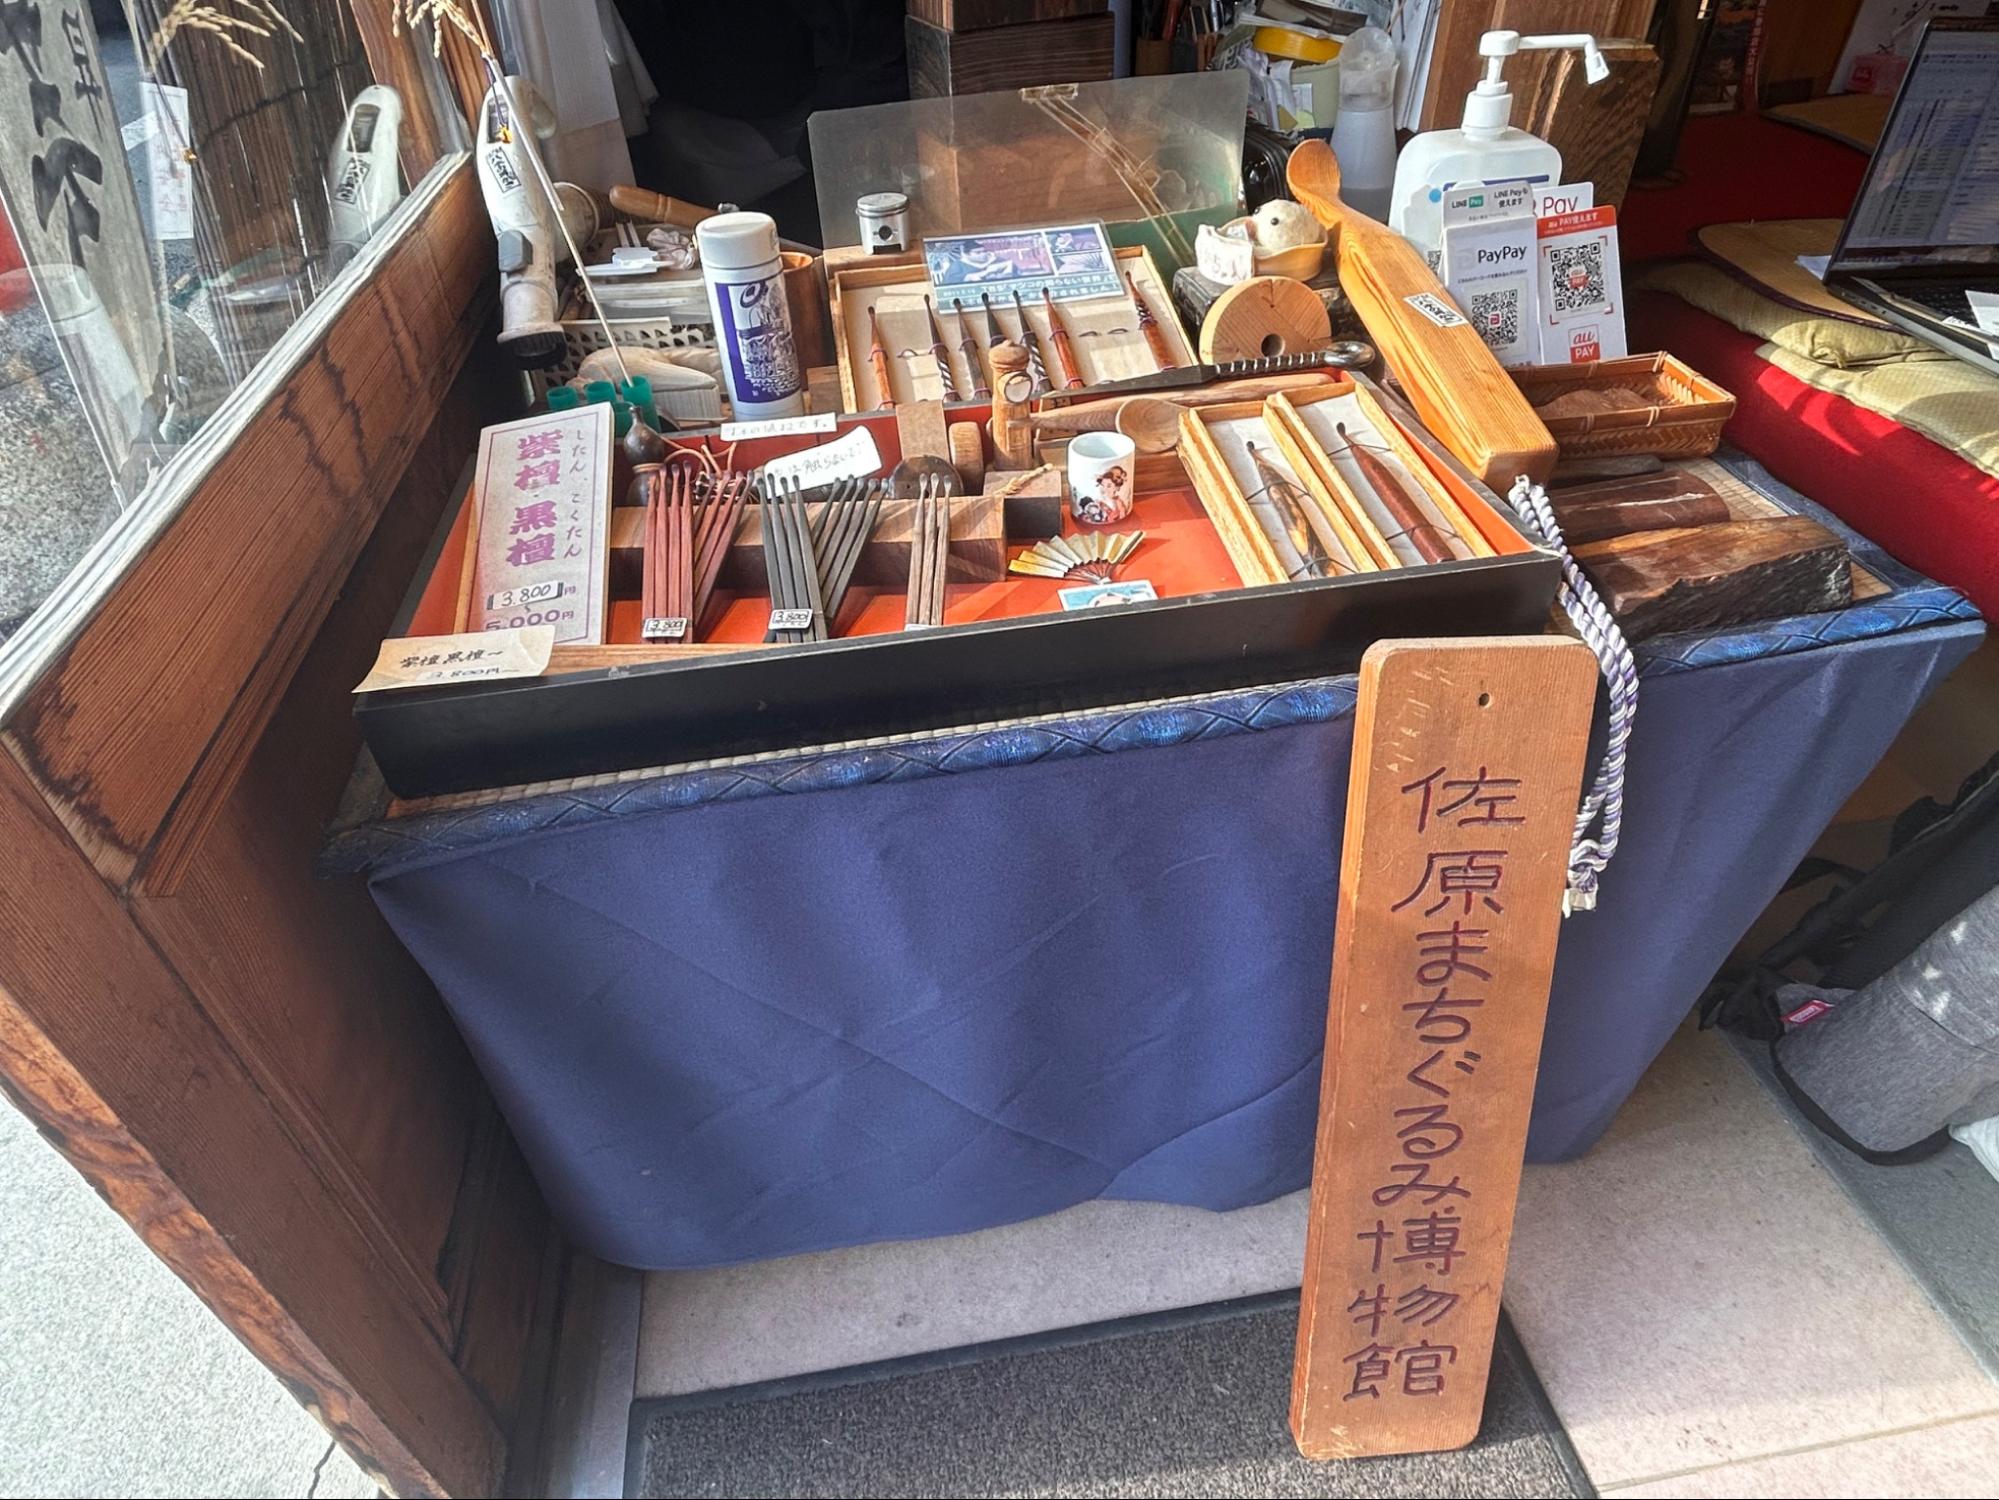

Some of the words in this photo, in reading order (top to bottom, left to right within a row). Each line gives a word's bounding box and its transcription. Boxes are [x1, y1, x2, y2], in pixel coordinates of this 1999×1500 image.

[1477, 245, 1527, 264] PayPay
[1573, 331, 1595, 345] au
[1575, 344, 1595, 359] PAY
[1342, 765, 1526, 1401] 佐原まちぐるみ博物館
